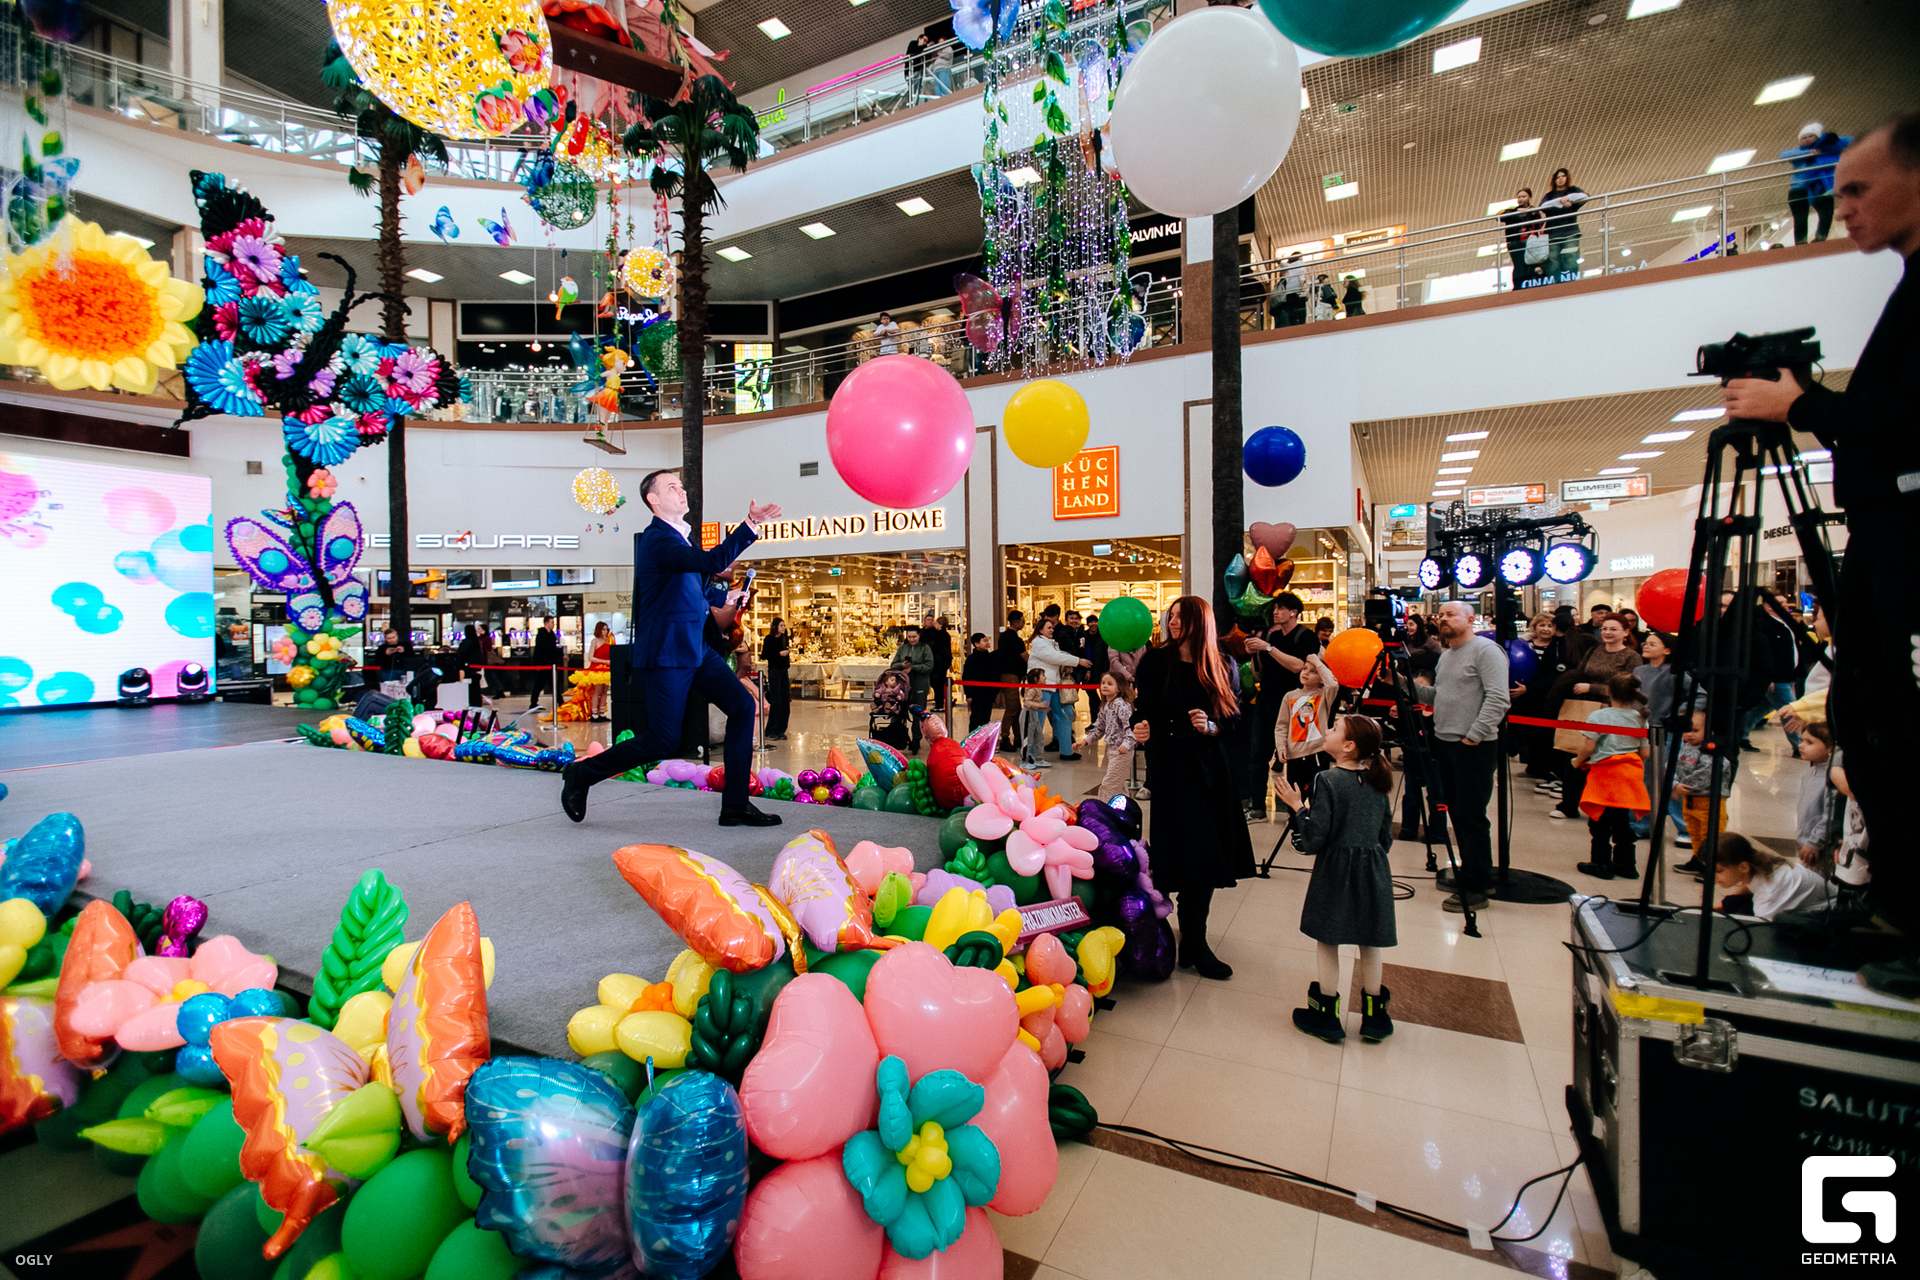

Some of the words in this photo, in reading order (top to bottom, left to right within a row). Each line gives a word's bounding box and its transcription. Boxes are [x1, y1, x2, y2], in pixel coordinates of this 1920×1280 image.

[616, 306, 644, 326] Pepe
[1063, 457, 1107, 474] KÜC
[1063, 475, 1108, 490] HEN
[1568, 483, 1622, 493] CLIMBER
[1063, 493, 1109, 508] LAND
[873, 509, 943, 532] HOME
[1763, 525, 1793, 540] DIESEL
[415, 533, 579, 550] SQUARE
